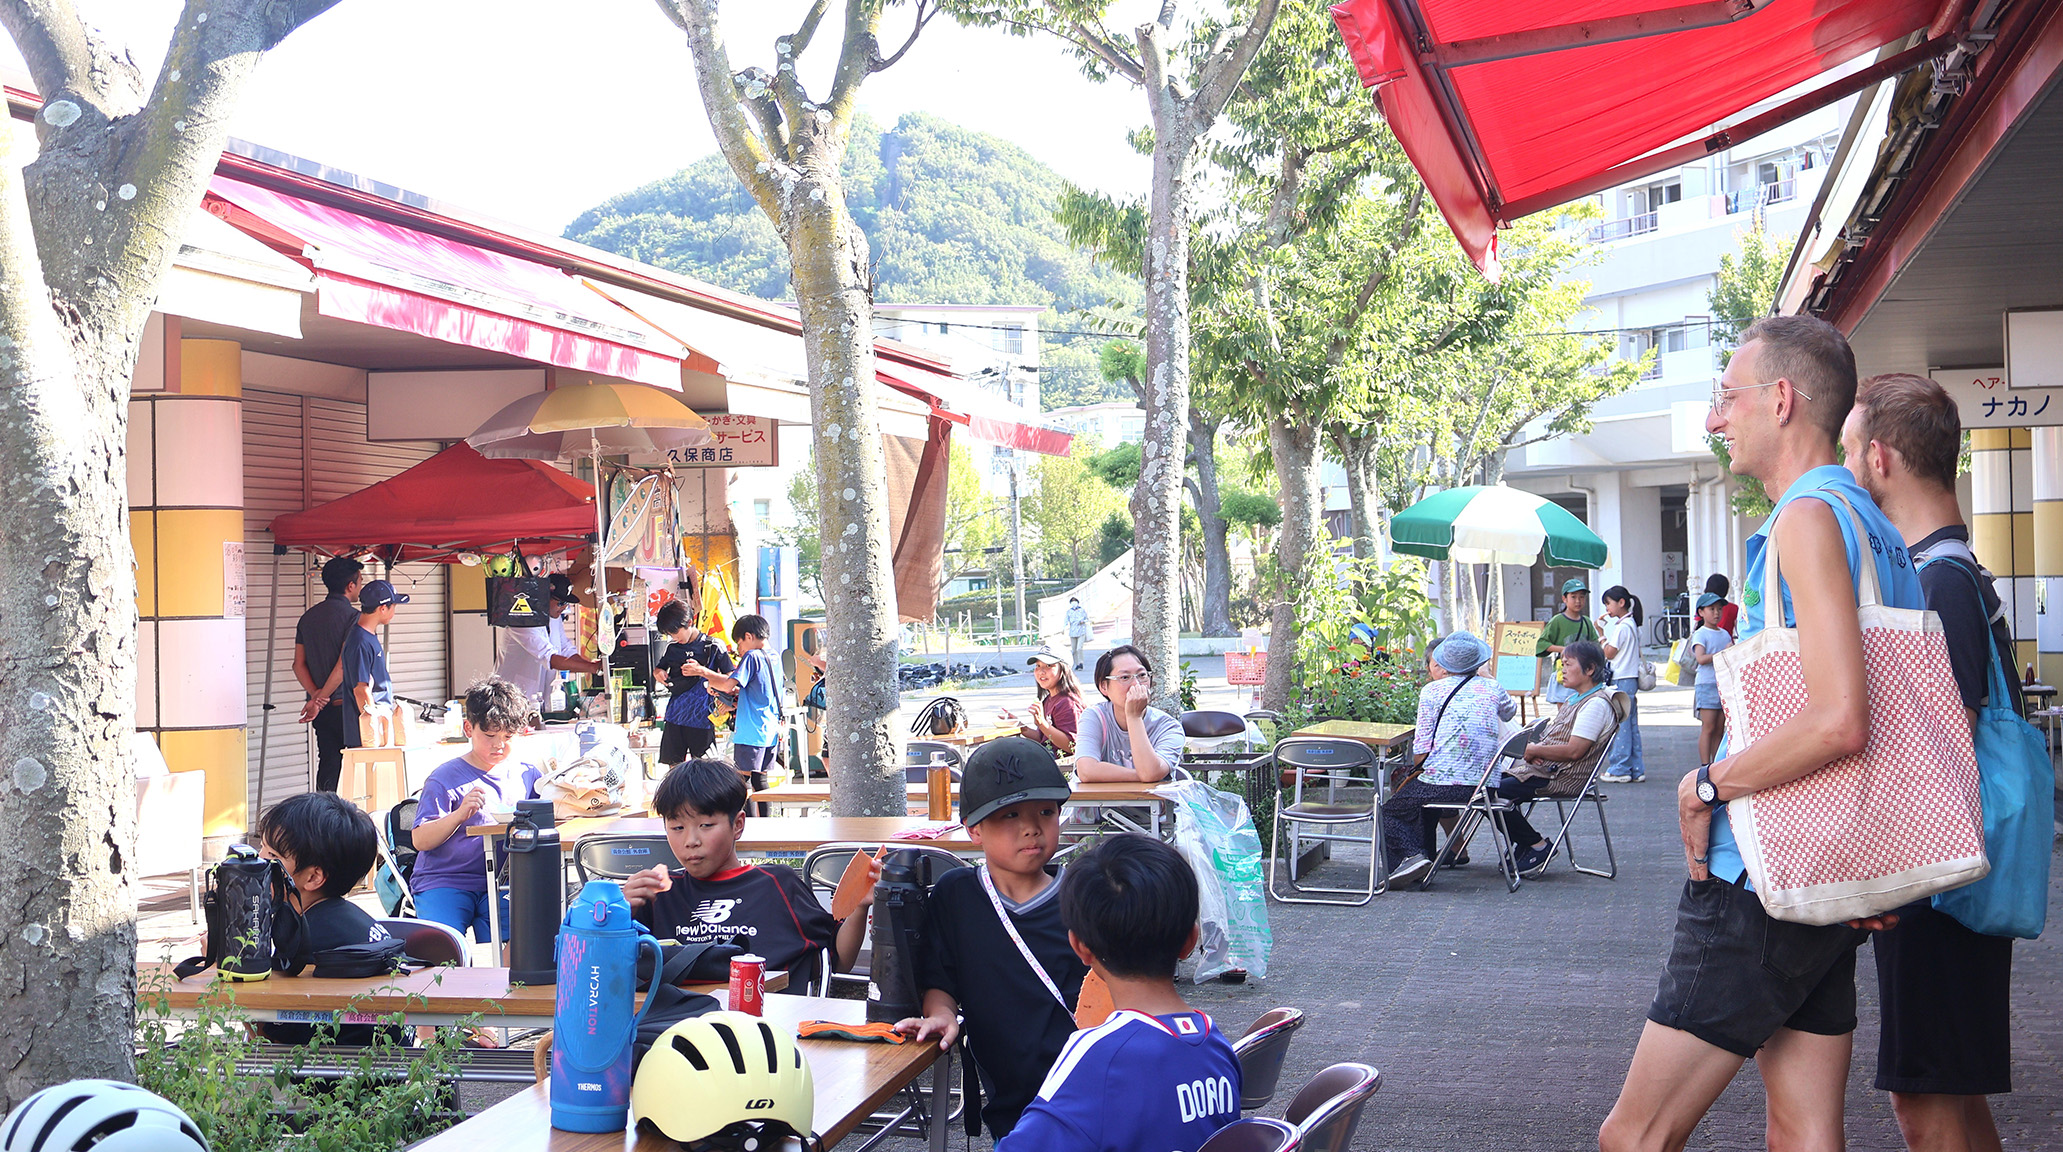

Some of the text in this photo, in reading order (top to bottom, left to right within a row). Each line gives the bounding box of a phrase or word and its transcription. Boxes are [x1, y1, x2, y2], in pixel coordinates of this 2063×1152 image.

[1982, 395, 2050, 418] ナカノ
[716, 430, 766, 444] サービス
[667, 448, 734, 462] 久保商店
[587, 965, 600, 1035] HYDRATION
[577, 1083, 602, 1092] THERMOS
